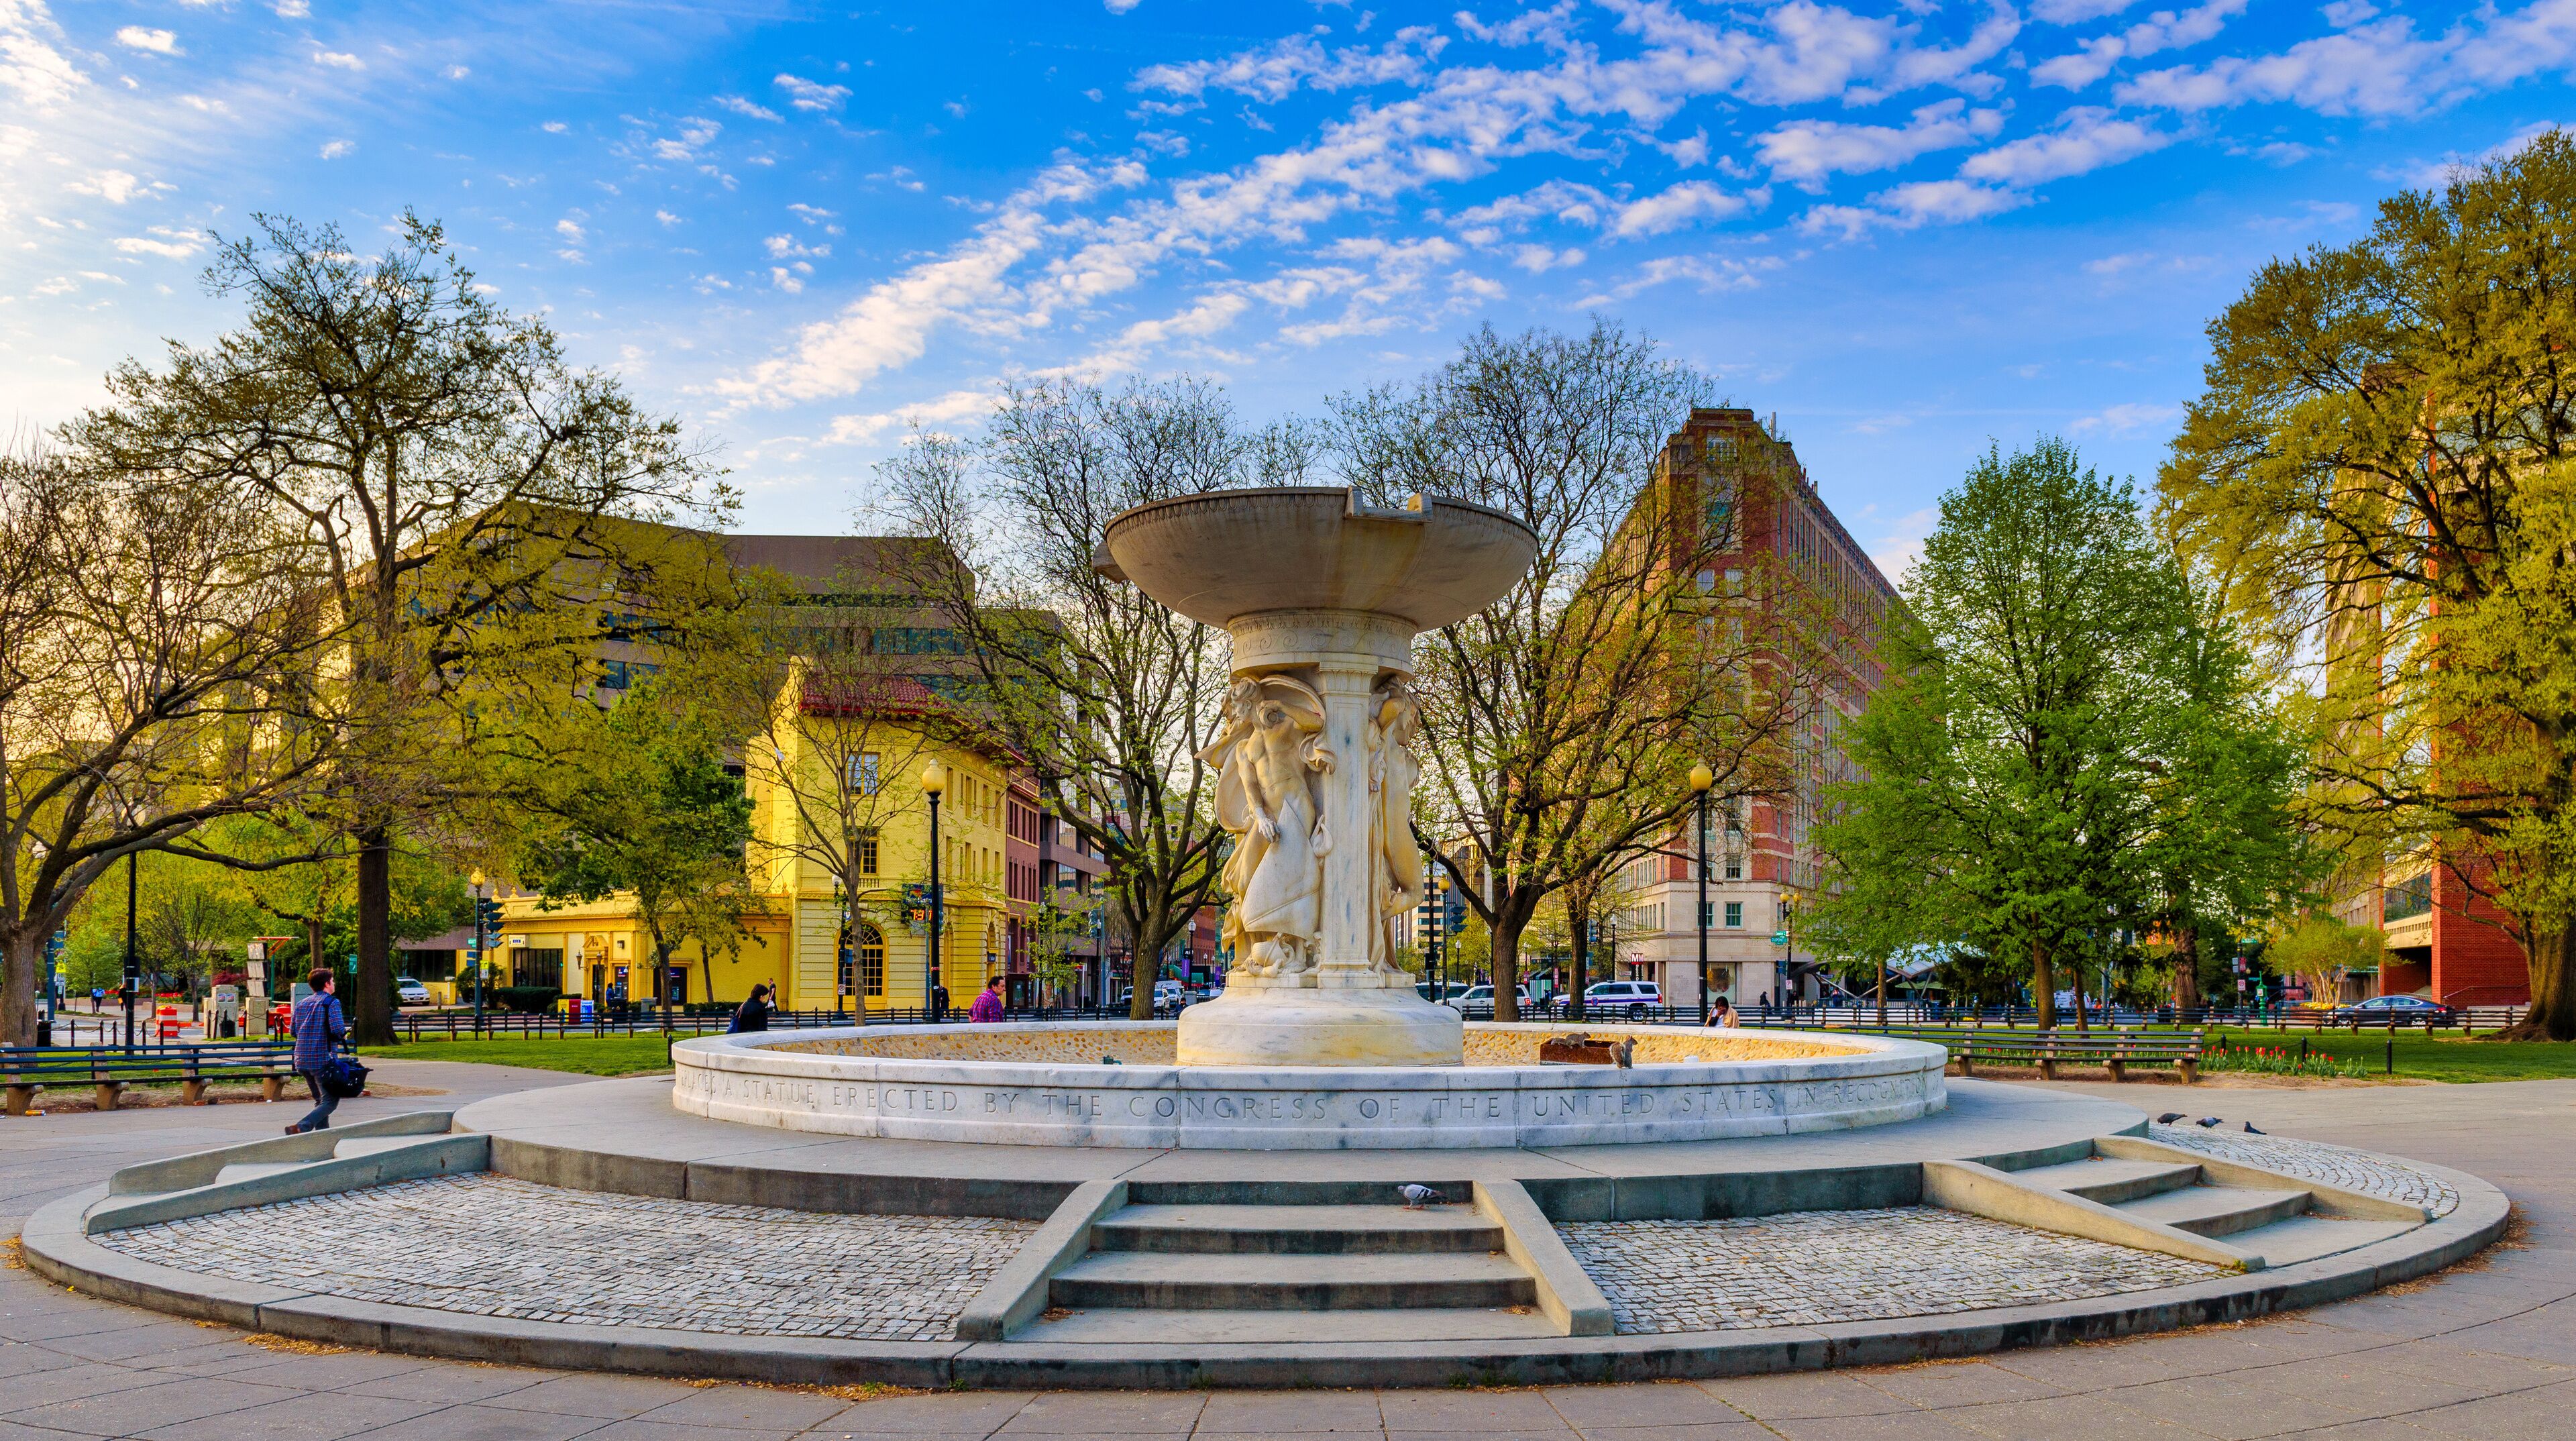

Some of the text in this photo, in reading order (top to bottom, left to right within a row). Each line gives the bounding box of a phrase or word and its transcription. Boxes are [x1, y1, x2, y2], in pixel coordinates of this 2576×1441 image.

[1631, 953, 1639, 962] M
[724, 1077, 733, 1096] A
[743, 1079, 814, 1104] STATUE
[833, 1086, 958, 1112] ERECTED
[983, 1092, 1020, 1114] BY
[1042, 1094, 1102, 1116] THE
[1128, 1096, 1326, 1119] CONGRESS
[1359, 1098, 1400, 1119] OF
[1432, 1096, 1501, 1119] THE
[1532, 1093, 1655, 1117] UNITED
[1681, 1089, 1777, 1112] STATES
[1796, 1086, 1817, 1108] IN
